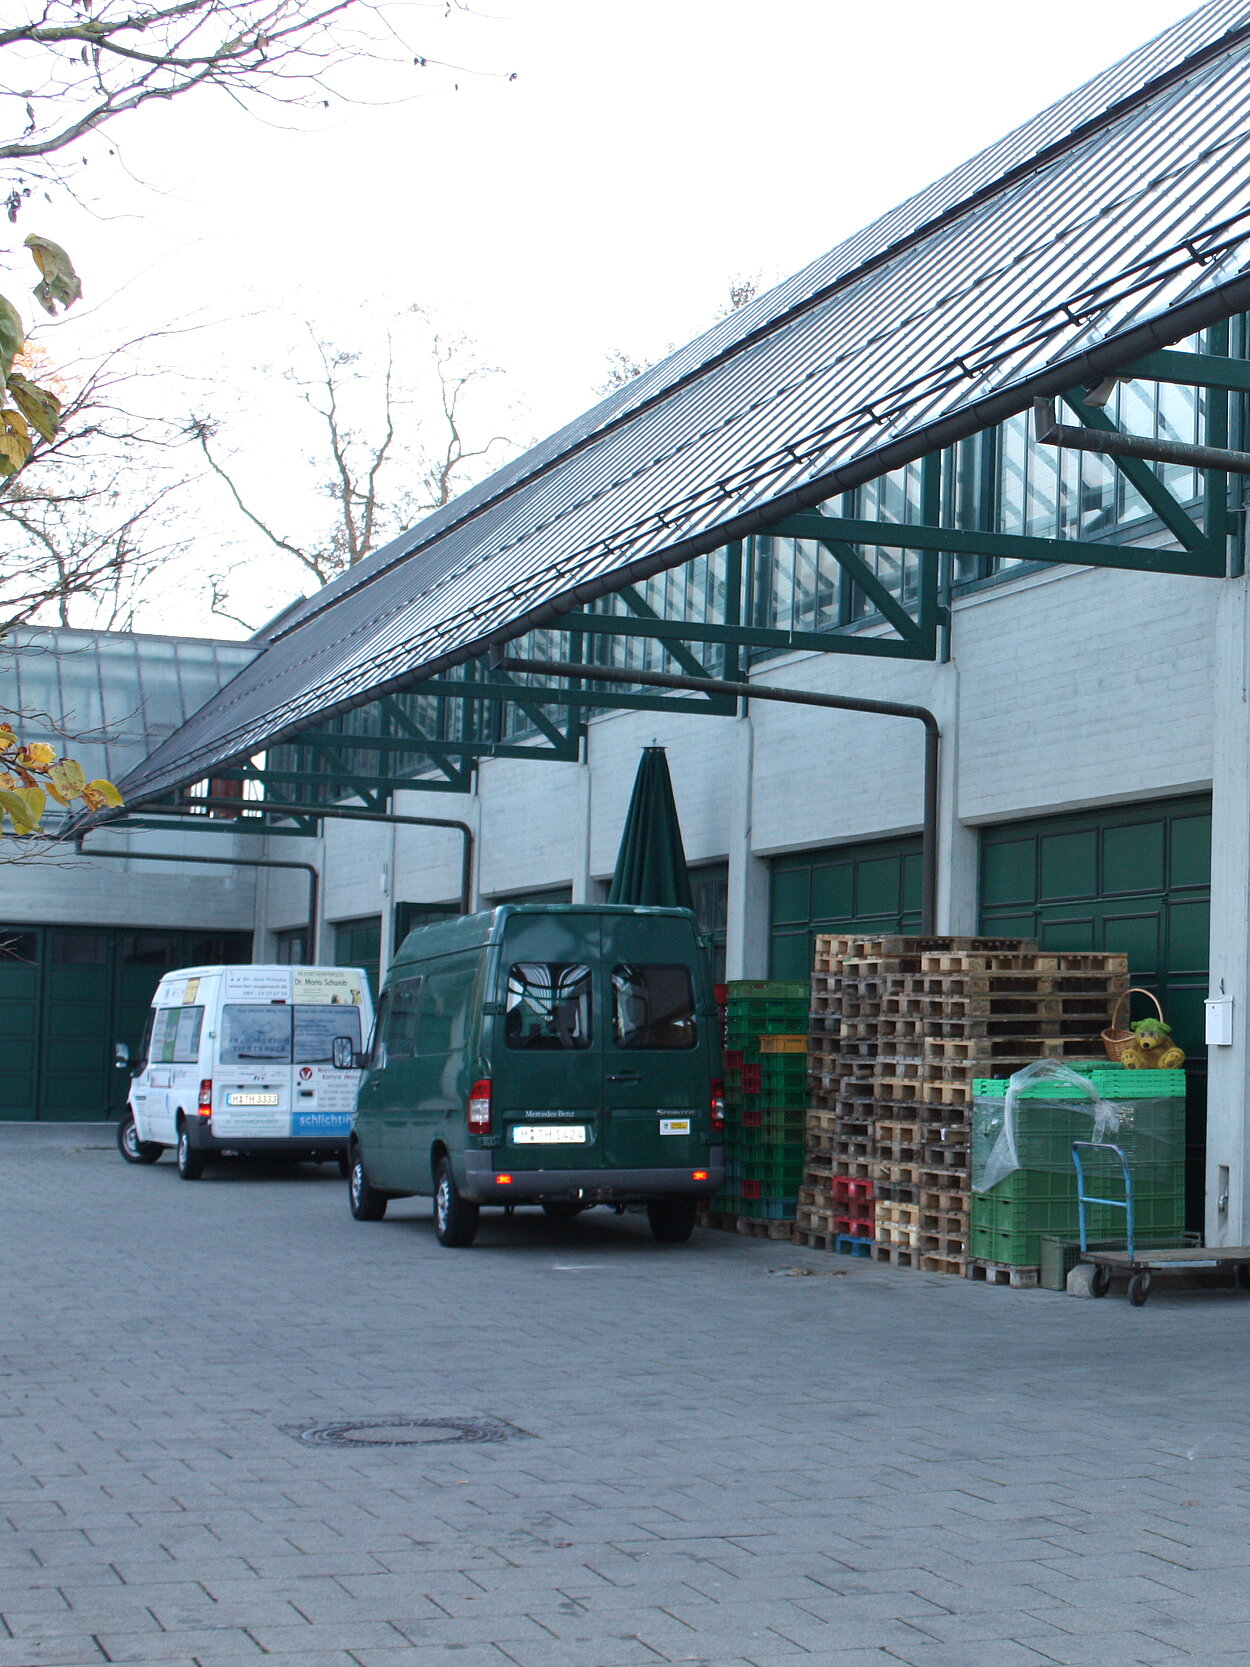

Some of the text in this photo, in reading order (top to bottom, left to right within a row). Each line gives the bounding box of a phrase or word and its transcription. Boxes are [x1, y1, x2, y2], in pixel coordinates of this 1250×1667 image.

[244, 1095, 255, 1104] TH
[256, 1095, 277, 1104] 3333
[299, 1114, 352, 1125] schlichtin
[538, 1129, 552, 1140] TH
[556, 1129, 584, 1141] 1424
